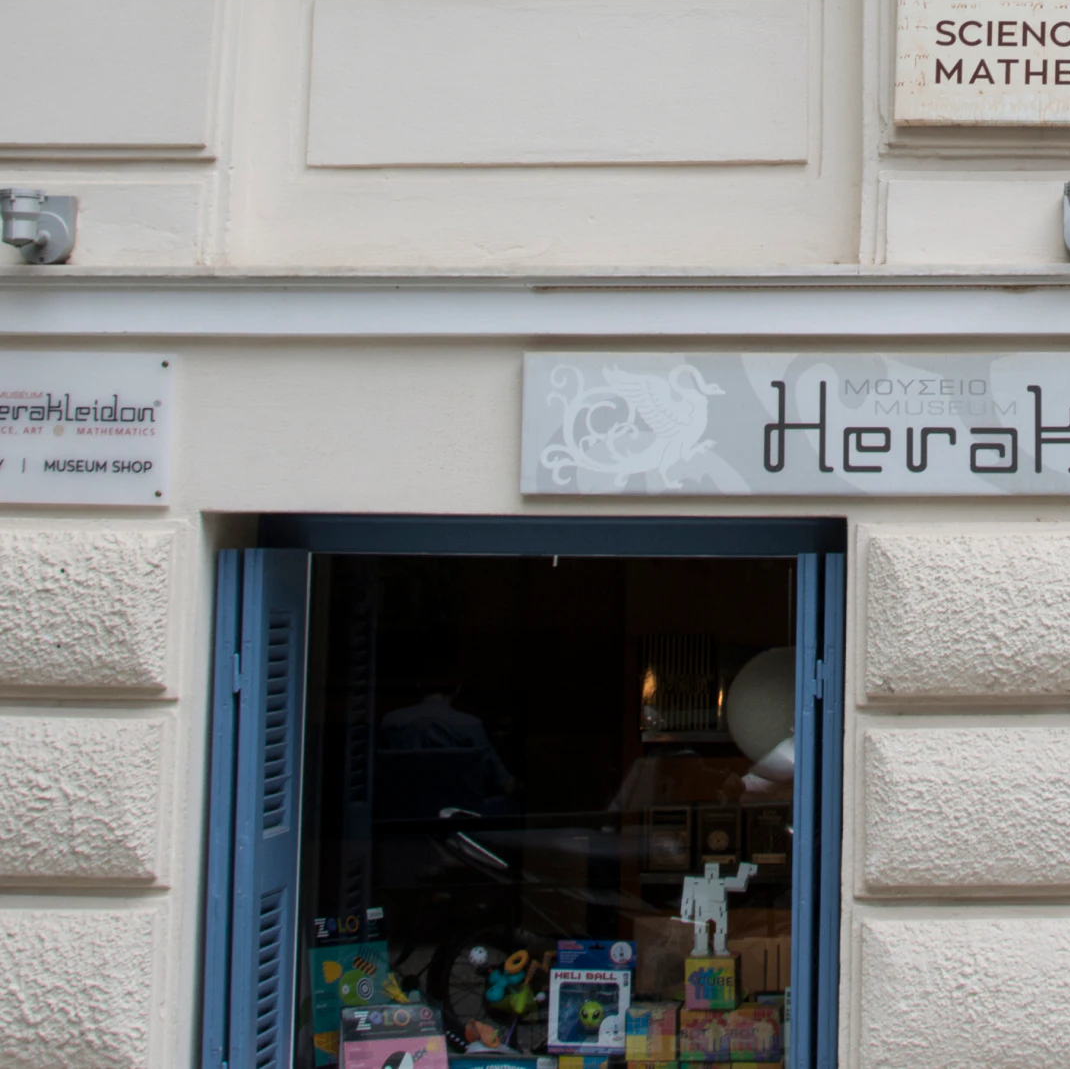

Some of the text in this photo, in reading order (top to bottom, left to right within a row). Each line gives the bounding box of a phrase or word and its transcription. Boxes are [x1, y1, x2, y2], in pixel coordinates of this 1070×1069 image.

[844, 379, 988, 396] ΜΟΥΣΕΙΟ
[873, 400, 1018, 416] MUSEUM
[22, 426, 44, 435] ART
[76, 427, 156, 436] MATHEMATICS
[44, 459, 154, 473] MUSEUM SHOP
[314, 914, 361, 939] ZOLO
[554, 972, 582, 981] HELI
[586, 972, 618, 981] BALL
[697, 975, 734, 987] CUBE
[353, 1009, 411, 1032] ZOLO
